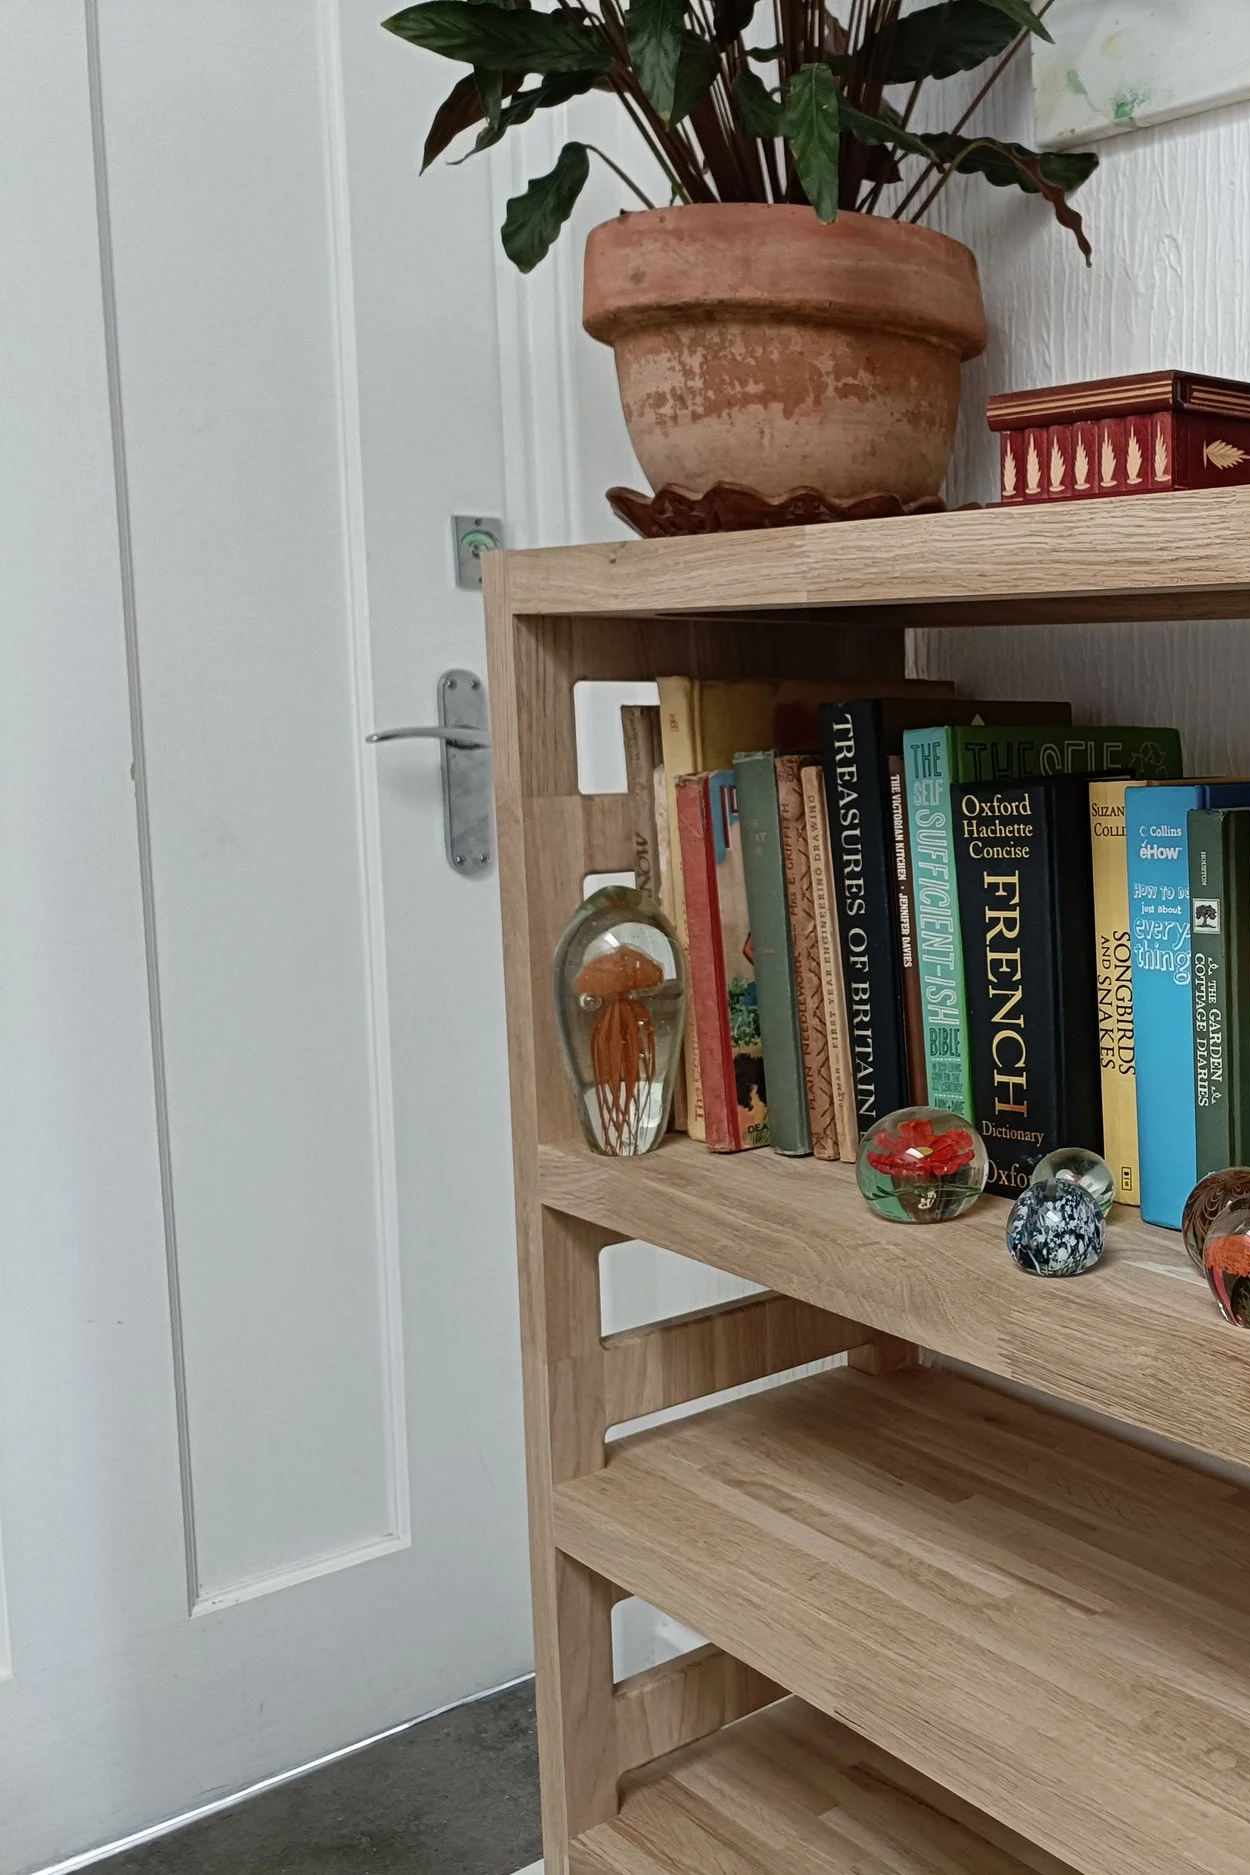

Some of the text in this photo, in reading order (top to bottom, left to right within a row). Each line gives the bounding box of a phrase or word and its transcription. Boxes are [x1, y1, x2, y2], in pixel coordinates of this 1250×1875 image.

[910, 741, 942, 778] THE
[913, 779, 943, 806] SELF
[961, 794, 1032, 817] Oxford
[781, 803, 795, 870] GRIFFITH
[807, 794, 821, 862] DRAWING
[962, 820, 1034, 838] Hachette
[969, 841, 1030, 859] Concise
[1150, 825, 1182, 837] Collins
[890, 774, 913, 968] THE VICTORIAN KITCHEN JENNIFER DAVIES
[1139, 844, 1180, 859] eHow
[815, 869, 831, 964] ENGINEERING
[832, 713, 877, 1118] TREASURES OF BRITAIN
[915, 809, 960, 1027] SUFFICIENT-ISH
[1141, 902, 1182, 915] just about
[1134, 941, 1191, 985] thing
[794, 951, 811, 1056] NEEDLEWORK
[826, 969, 835, 1004] YEAR
[983, 870, 1028, 1118] FRENCH
[1098, 935, 1115, 1070] AND SNAKES
[1112, 931, 1136, 1075] SONGBIRDS
[830, 1011, 839, 1049] FIRST
[929, 1027, 961, 1057] BIBLE
[1194, 952, 1208, 1107] COTTAGE DIARIES
[1208, 980, 1222, 1082] THE GARDEN
[805, 1066, 816, 1110] PLAIN
[981, 1120, 1045, 1147] Dictionary
